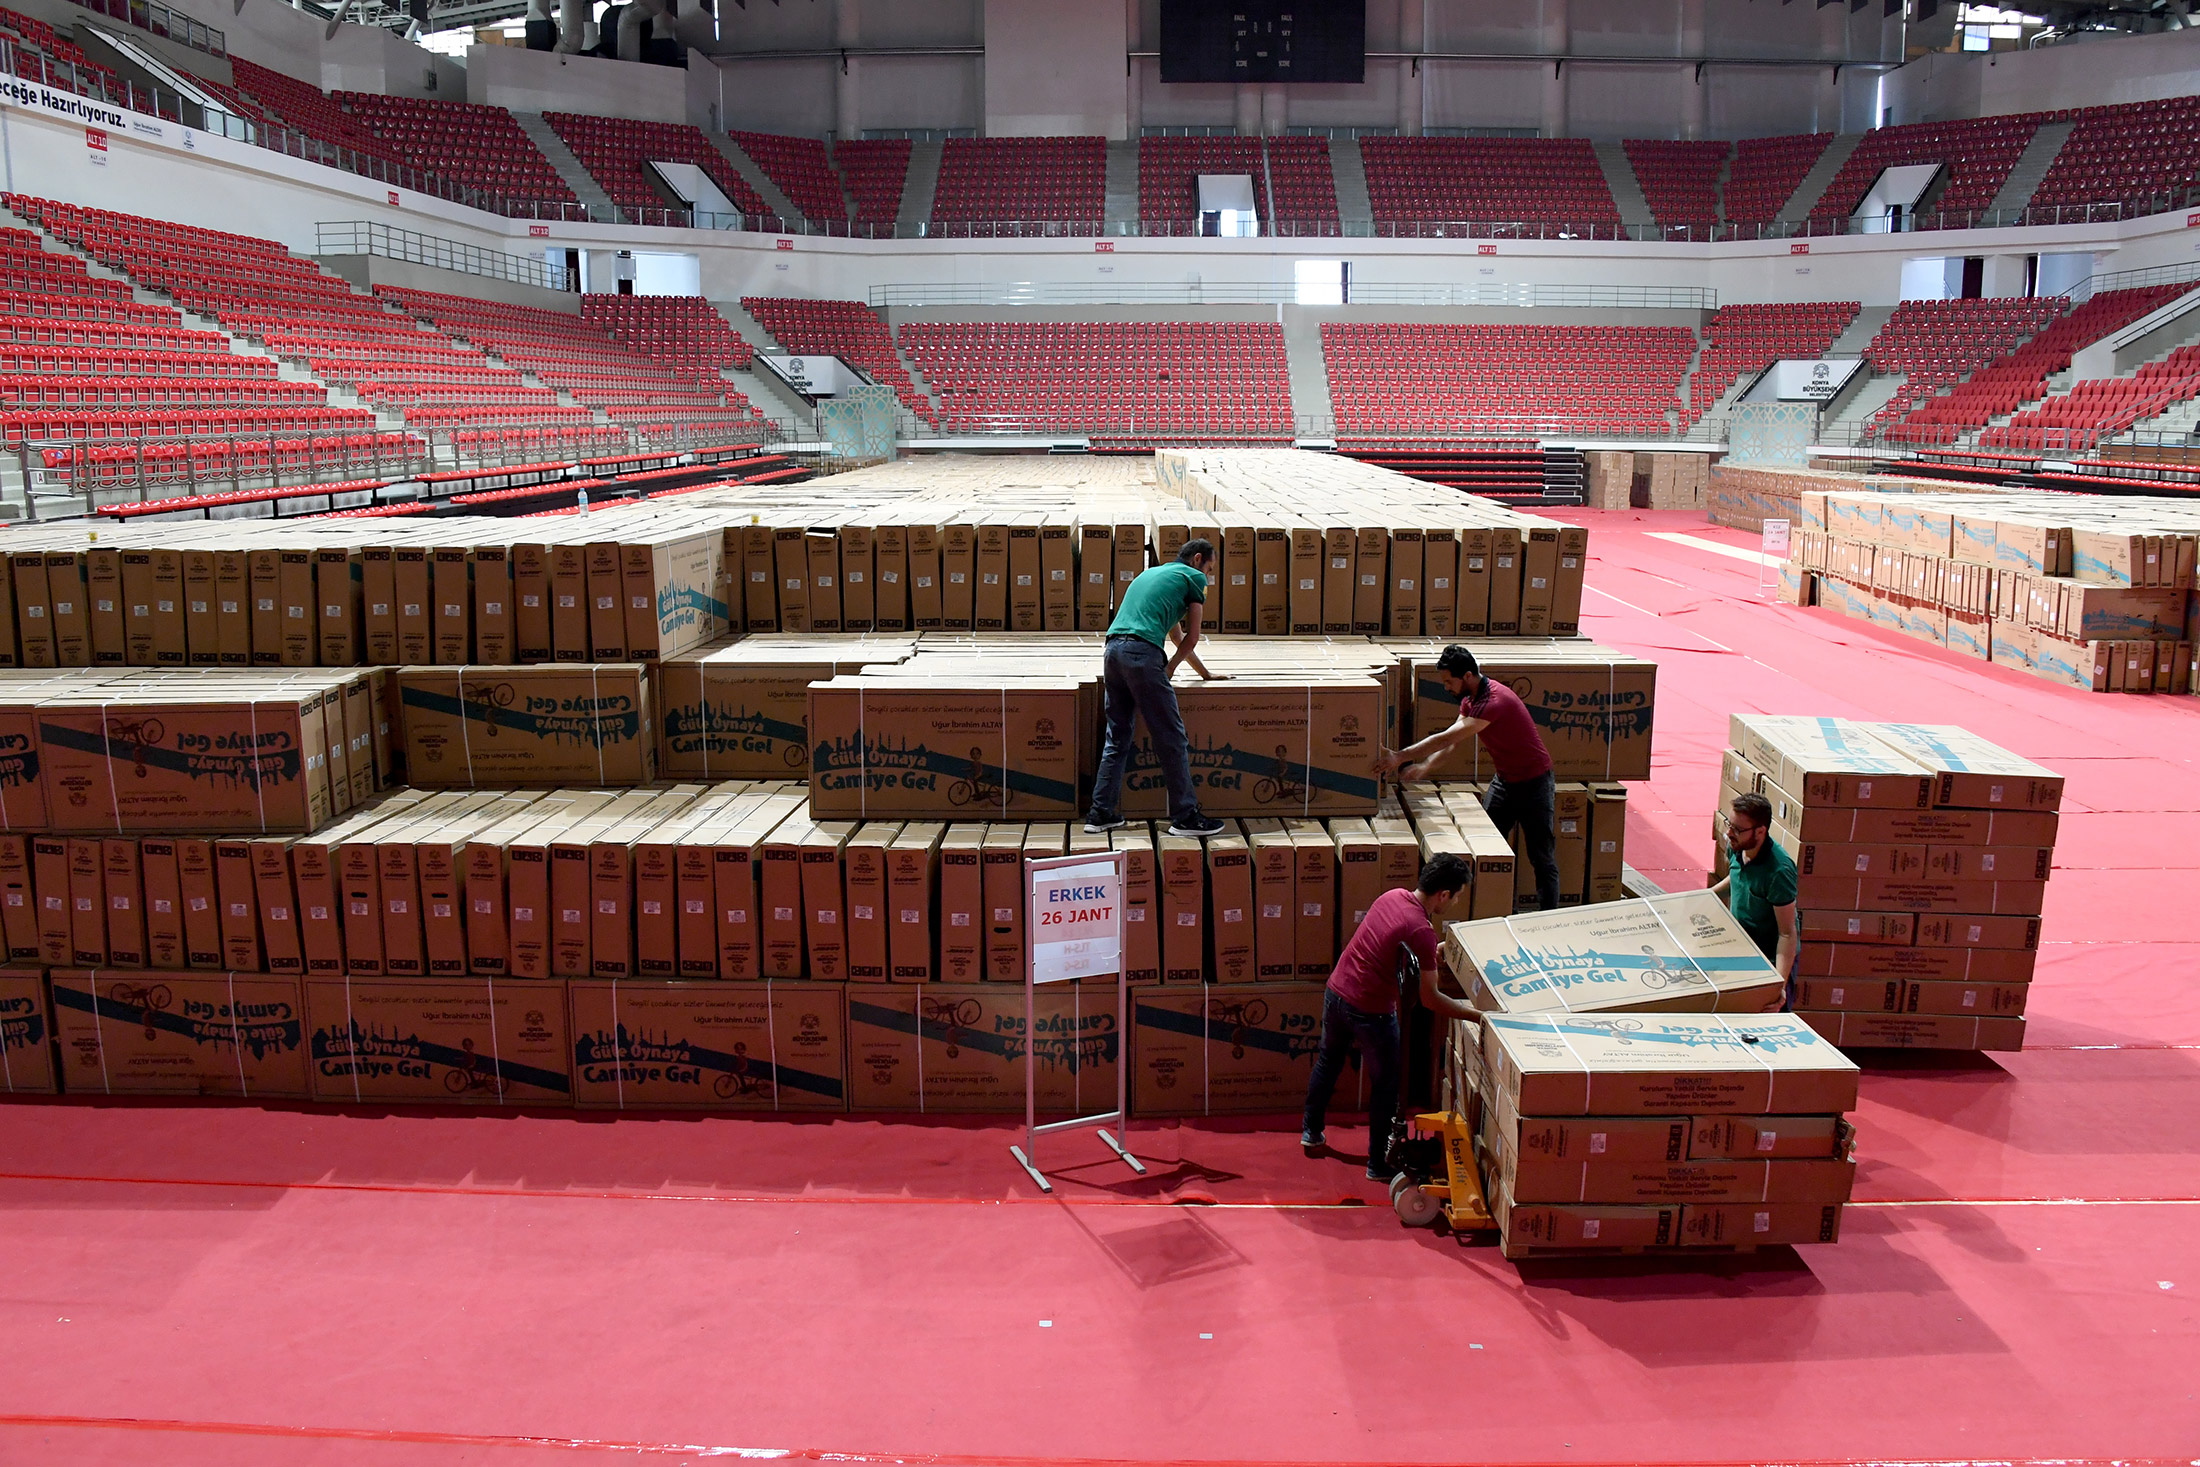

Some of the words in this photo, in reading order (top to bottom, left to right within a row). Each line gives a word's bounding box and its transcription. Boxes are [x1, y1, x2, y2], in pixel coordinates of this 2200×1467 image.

[40, 89, 126, 128] Hazırlıyoruz.
[526, 696, 558, 714] Gel
[561, 695, 632, 716] Camiye
[1542, 690, 1574, 708] Gel
[1578, 690, 1646, 710] Camiye
[535, 718, 589, 734] Oynaya
[592, 718, 626, 732] Güle
[678, 718, 708, 732] Güle
[712, 716, 764, 734] Oynaya
[932, 721, 950, 730] Uğur
[952, 720, 980, 728] İbrahim
[1238, 720, 1256, 728] Uğur
[1550, 712, 1601, 727] Oynaya
[1604, 713, 1638, 726] Güle
[176, 732, 212, 752] Gel
[215, 730, 292, 754] Camiye
[672, 734, 738, 754] Camiye
[742, 736, 773, 755] Gel
[188, 756, 245, 776] Oynaya
[248, 756, 286, 772] Güle
[828, 751, 862, 766] Güle
[869, 750, 928, 768] Oynaya
[1189, 752, 1233, 768] ynaya
[820, 768, 898, 792] Camiye
[901, 771, 936, 792] Gel
[1207, 771, 1242, 791] Gel
[1049, 885, 1106, 902] ERKEK
[1041, 911, 1062, 925] 26
[1068, 907, 1112, 923] JANT
[1590, 929, 1609, 937] Uğur
[1609, 926, 1638, 934] İbrahim
[1638, 922, 1660, 930] ALTAY
[1501, 962, 1539, 978] Güle
[1542, 956, 1605, 970] Oynaya
[1503, 972, 1585, 997] Camiye
[1586, 970, 1628, 982] Gel
[183, 998, 215, 1020] Gel
[219, 1001, 292, 1022] Camiye
[693, 1016, 712, 1024] Uğur
[994, 1014, 1028, 1036] Gel
[1035, 1013, 1116, 1038] Camiye
[1280, 1012, 1315, 1032] Gel
[193, 1023, 248, 1041] Oynaya
[250, 1026, 287, 1041] Güle
[1660, 1024, 1703, 1035] Gel
[325, 1040, 360, 1054] Güle
[363, 1038, 420, 1057] Oynaya
[590, 1044, 628, 1060] Güle
[631, 1044, 690, 1063] Oynaya
[1068, 1040, 1107, 1052] Güle
[320, 1056, 394, 1080] Camiye
[397, 1060, 432, 1080] Gel
[584, 1062, 662, 1084] Camiye
[665, 1066, 700, 1085] Gel
[925, 1077, 951, 1085] ALTAY
[951, 1076, 978, 1085] İbrahim
[978, 1076, 999, 1085] Uğur
[1452, 1138, 1464, 1165] best
